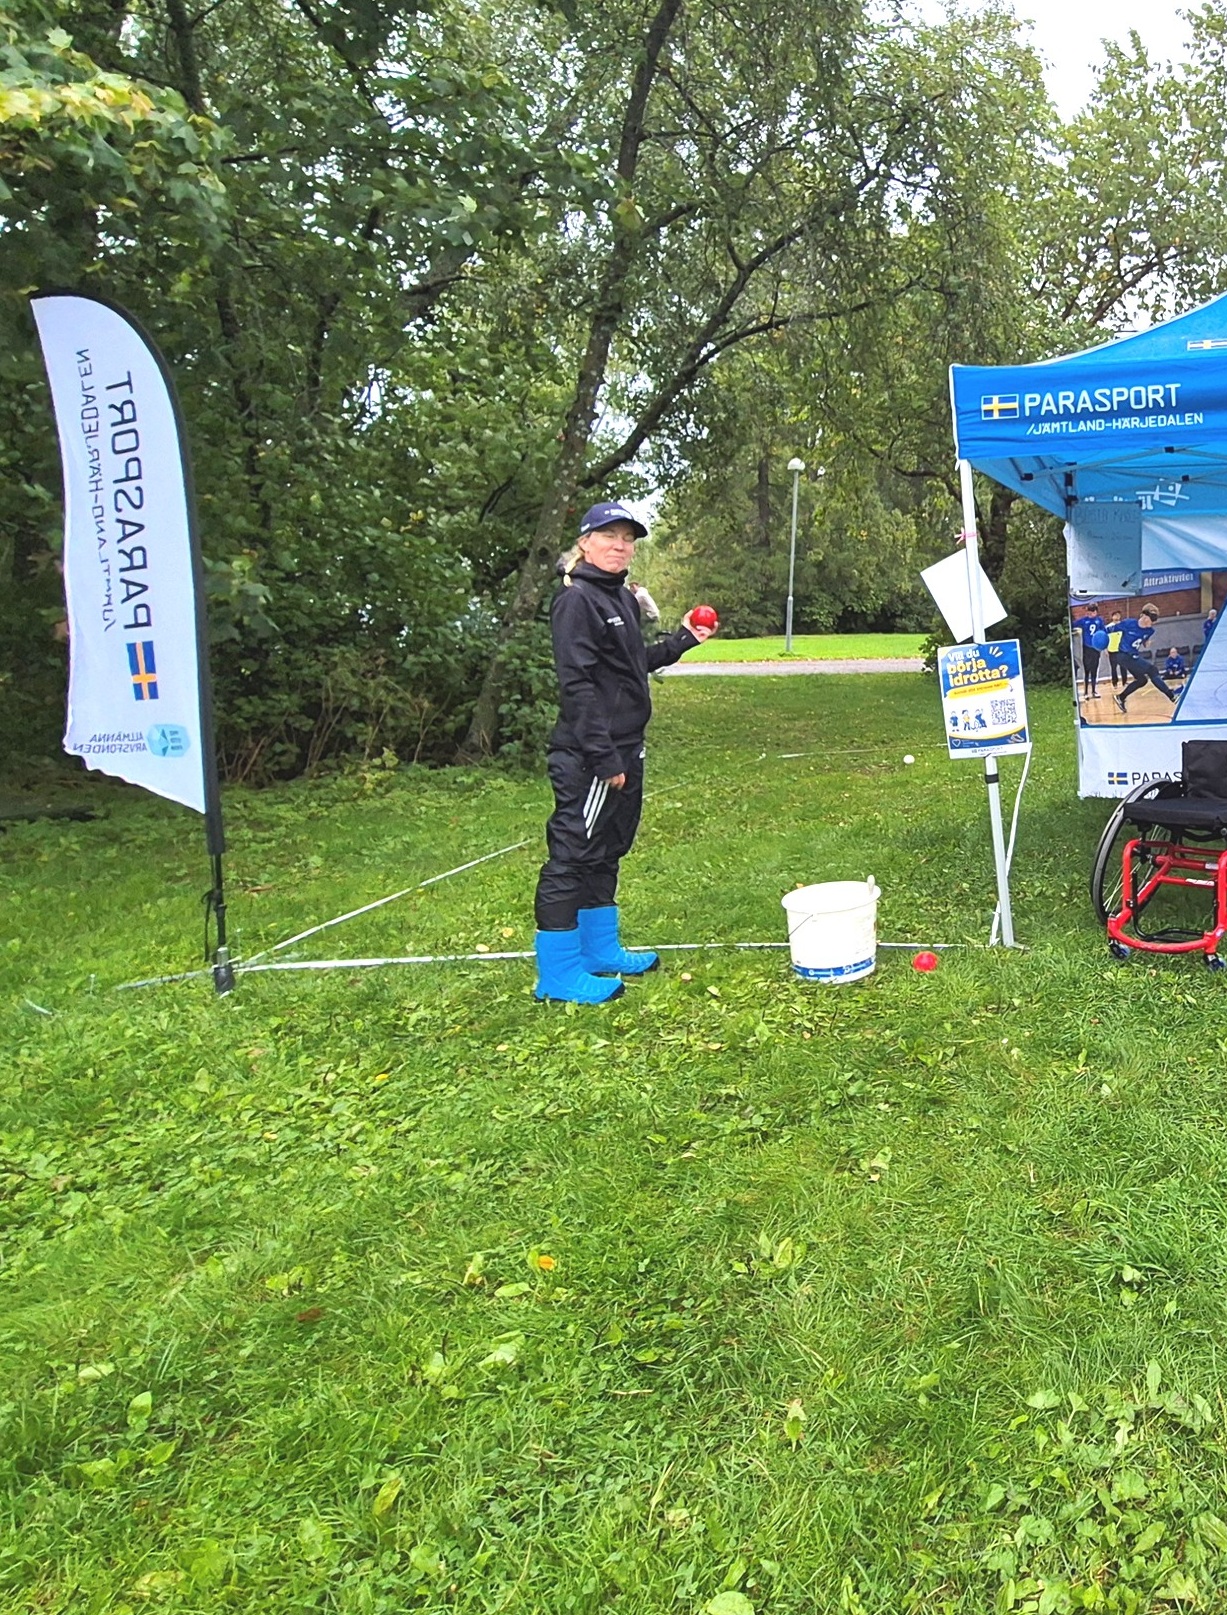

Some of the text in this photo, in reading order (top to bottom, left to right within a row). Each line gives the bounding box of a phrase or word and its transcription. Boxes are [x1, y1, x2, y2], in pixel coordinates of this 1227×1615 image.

[1024, 383, 1181, 417] PARASPORT
[1026, 412, 1203, 435] /JÄMTLAND-HÄRJEDALEN
[966, 648, 980, 659] du
